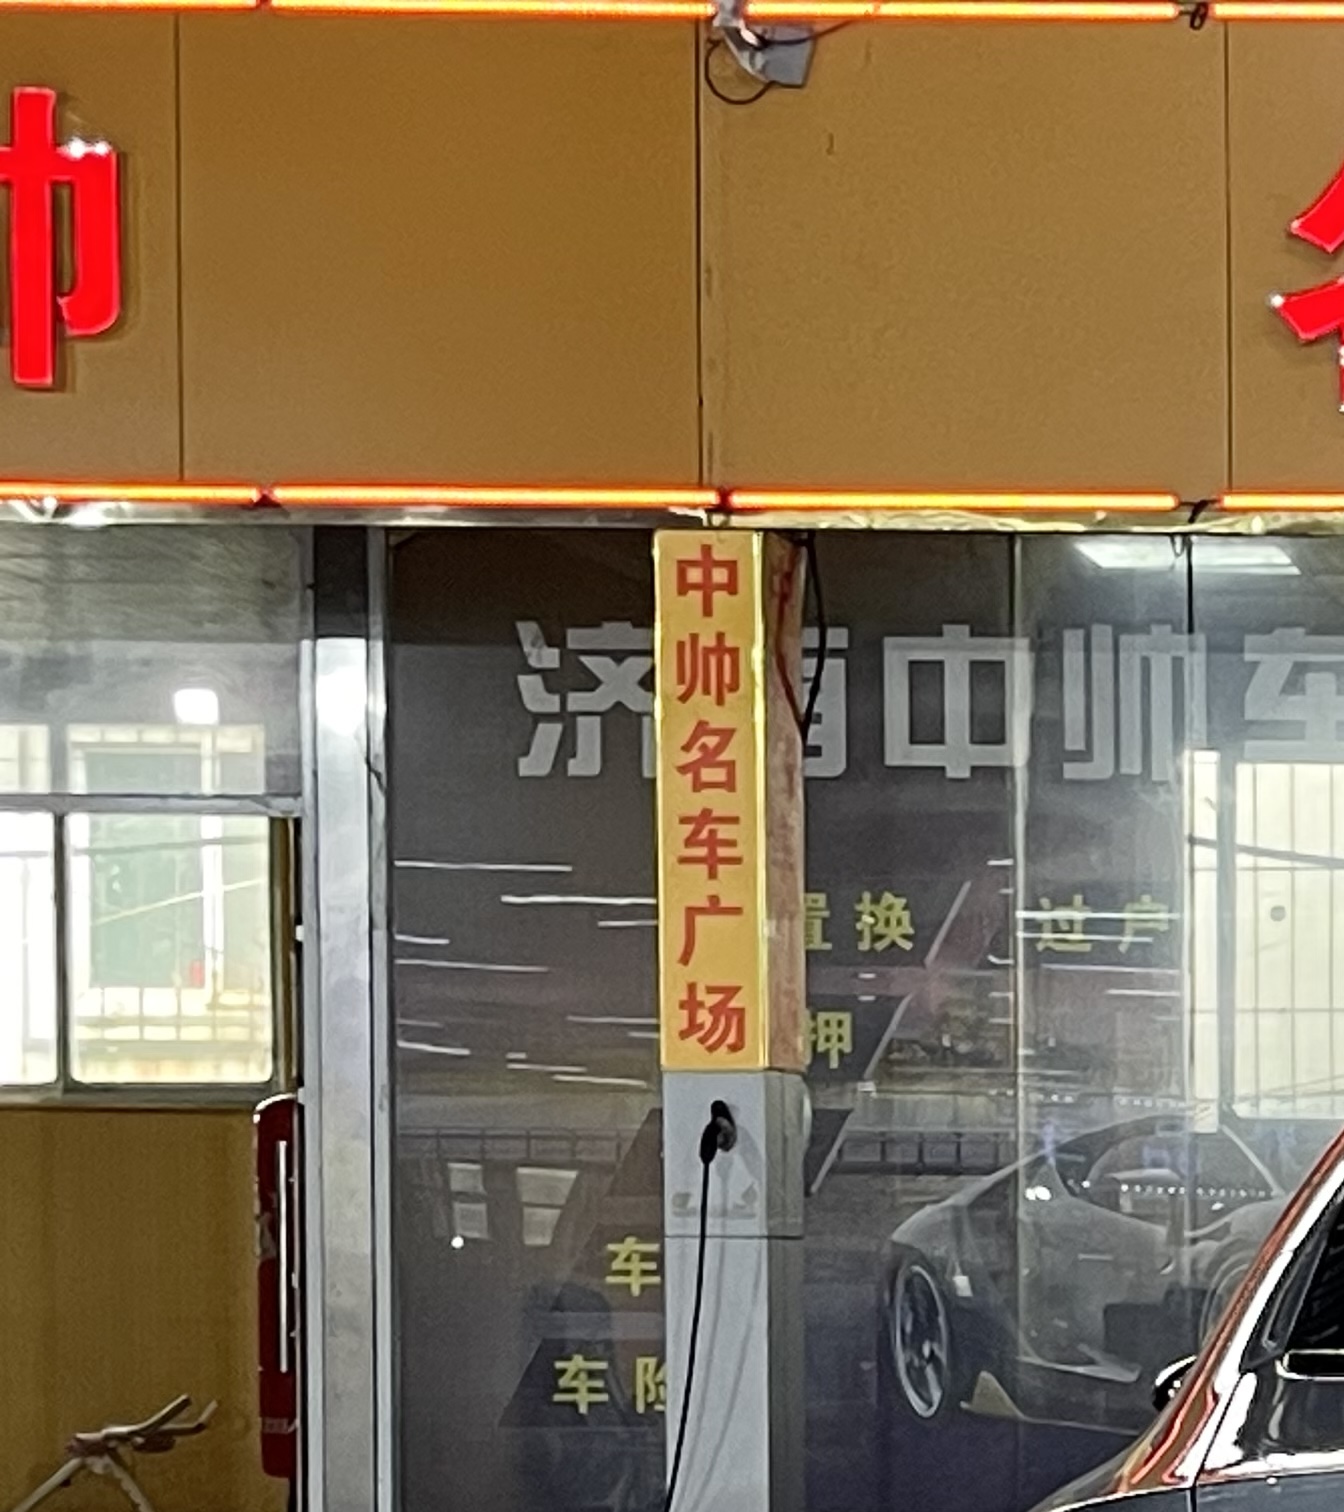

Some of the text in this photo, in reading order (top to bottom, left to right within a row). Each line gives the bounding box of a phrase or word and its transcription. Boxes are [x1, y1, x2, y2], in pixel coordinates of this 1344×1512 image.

[675, 542, 747, 1055] 中帅名车广场
[604, 1236, 662, 1298] 车
